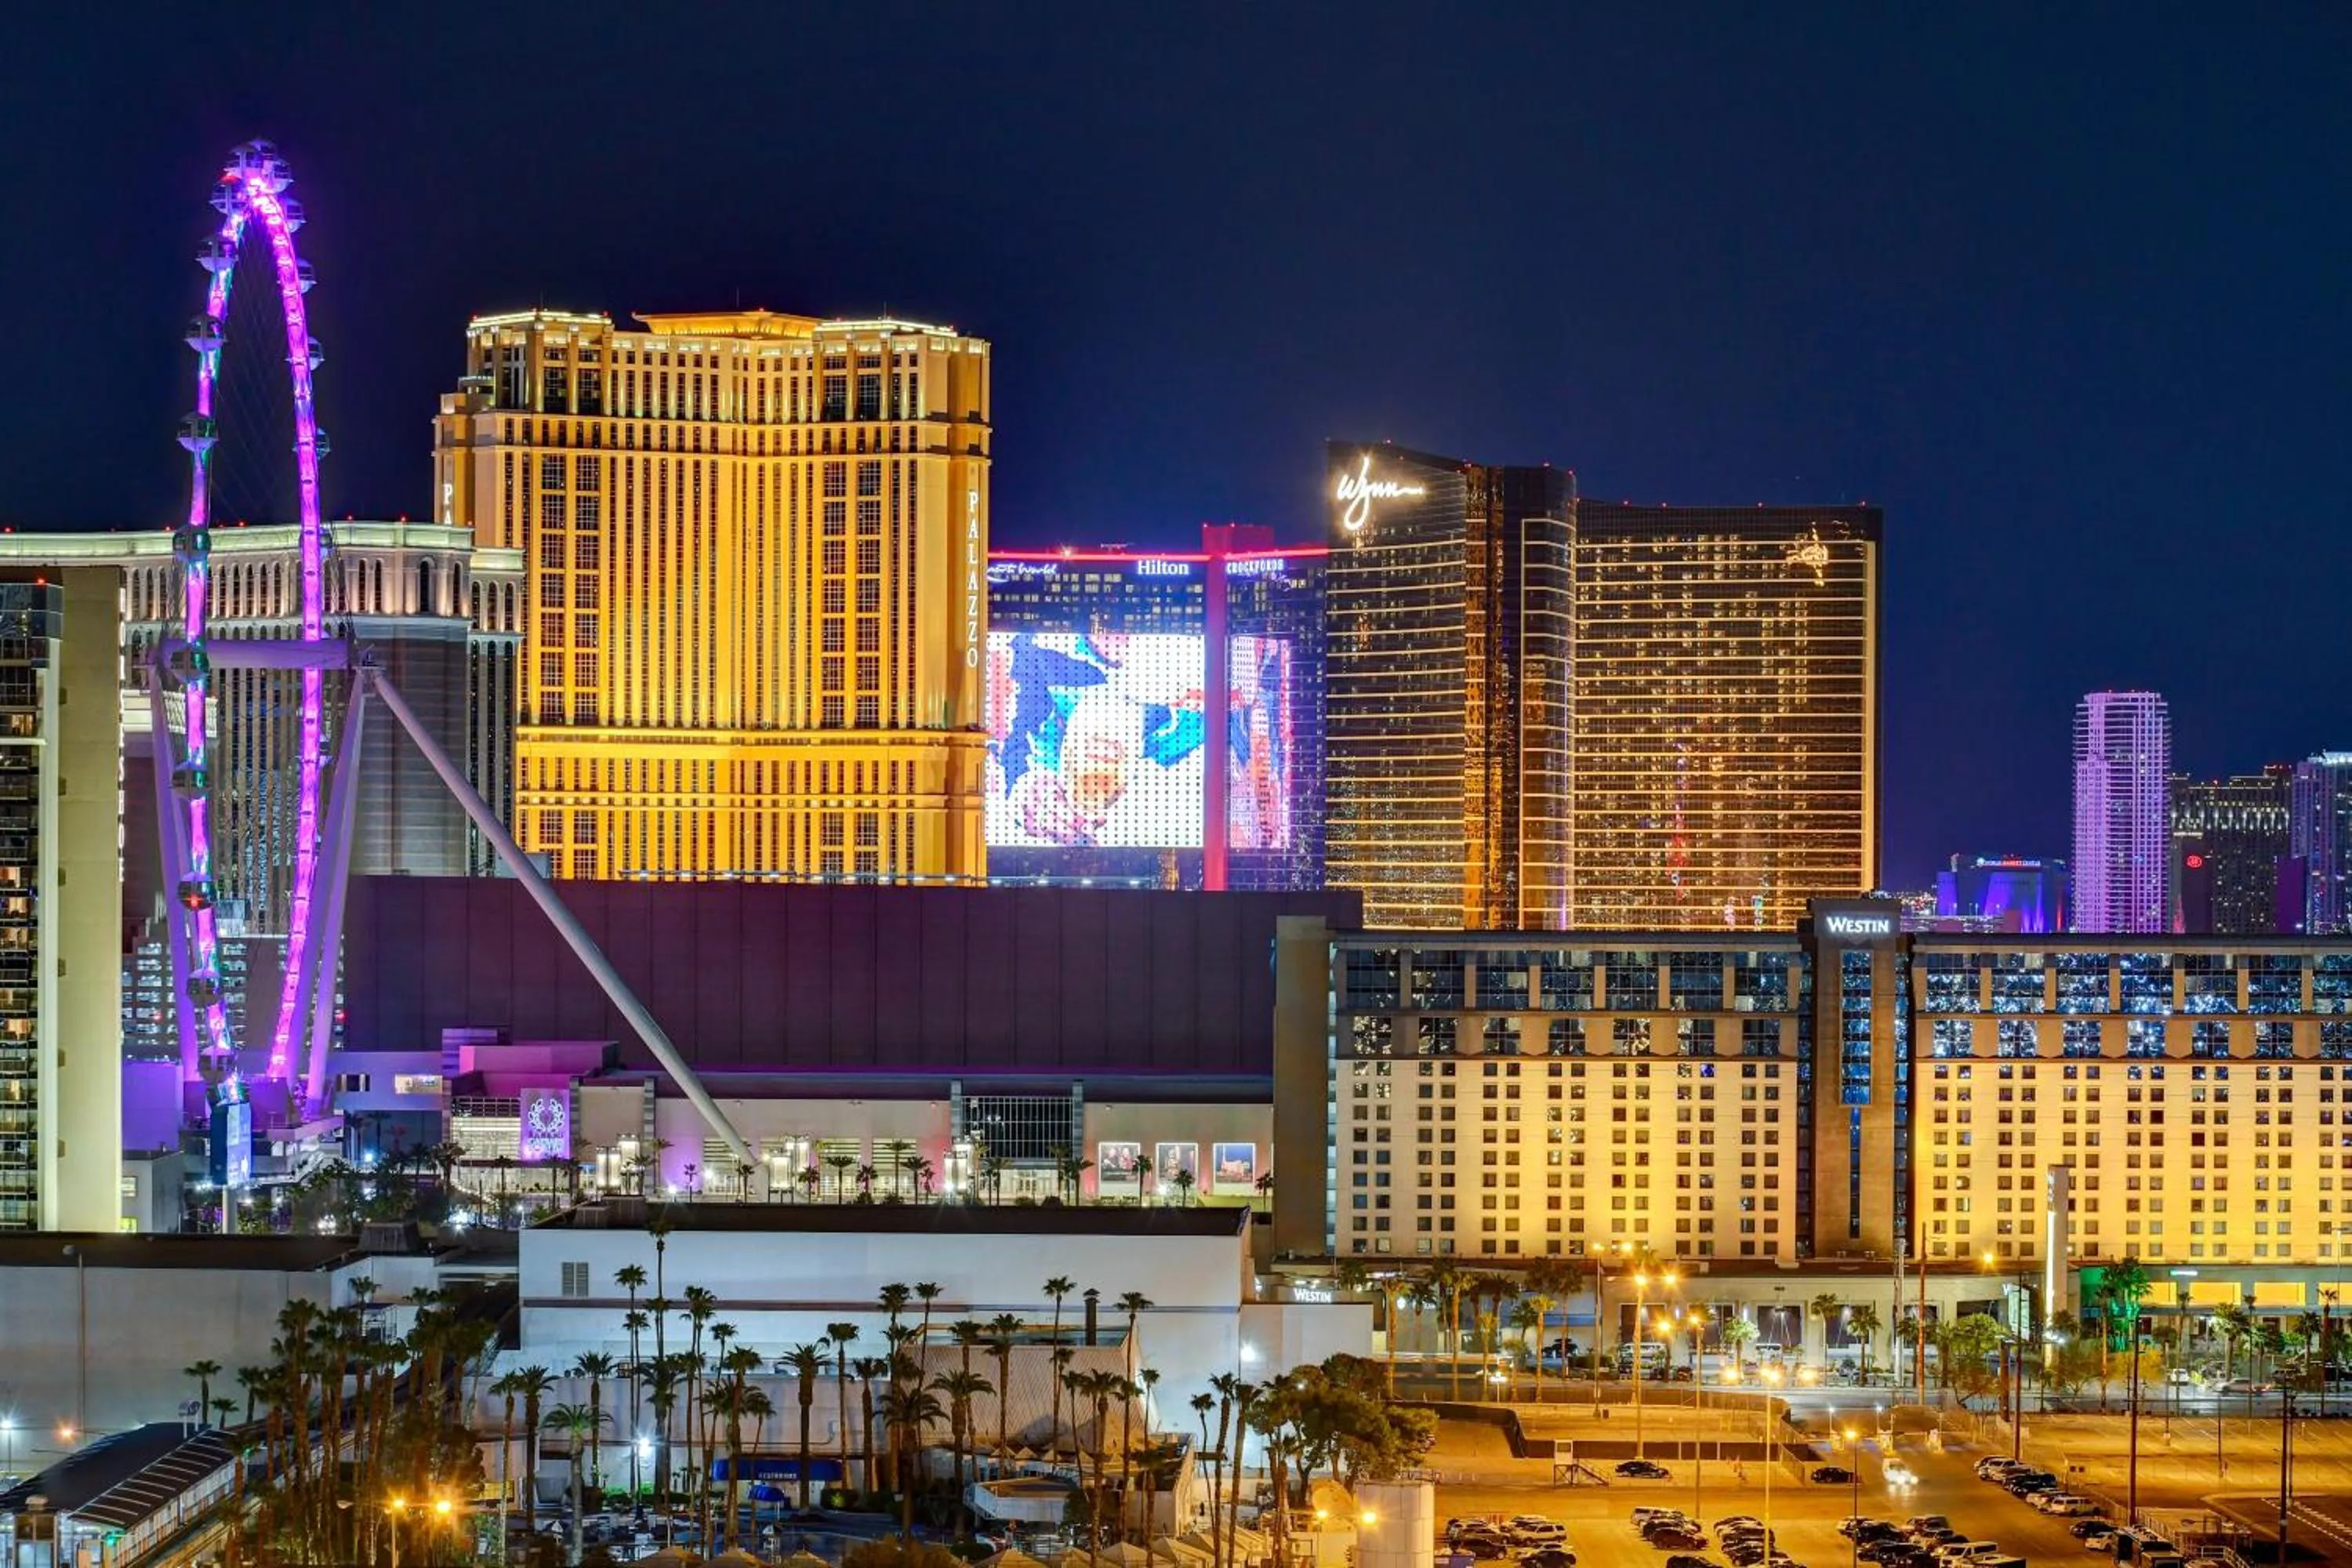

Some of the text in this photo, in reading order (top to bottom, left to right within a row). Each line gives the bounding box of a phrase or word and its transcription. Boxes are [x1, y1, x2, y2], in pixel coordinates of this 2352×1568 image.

[1138, 559, 1189, 575] Hilton
[1226, 558, 1284, 574] CROCKFORDS
[967, 492, 979, 667] PALAZZO
[1826, 916, 1889, 933] WESTIN
[1294, 1287, 1331, 1303] WESTIN
